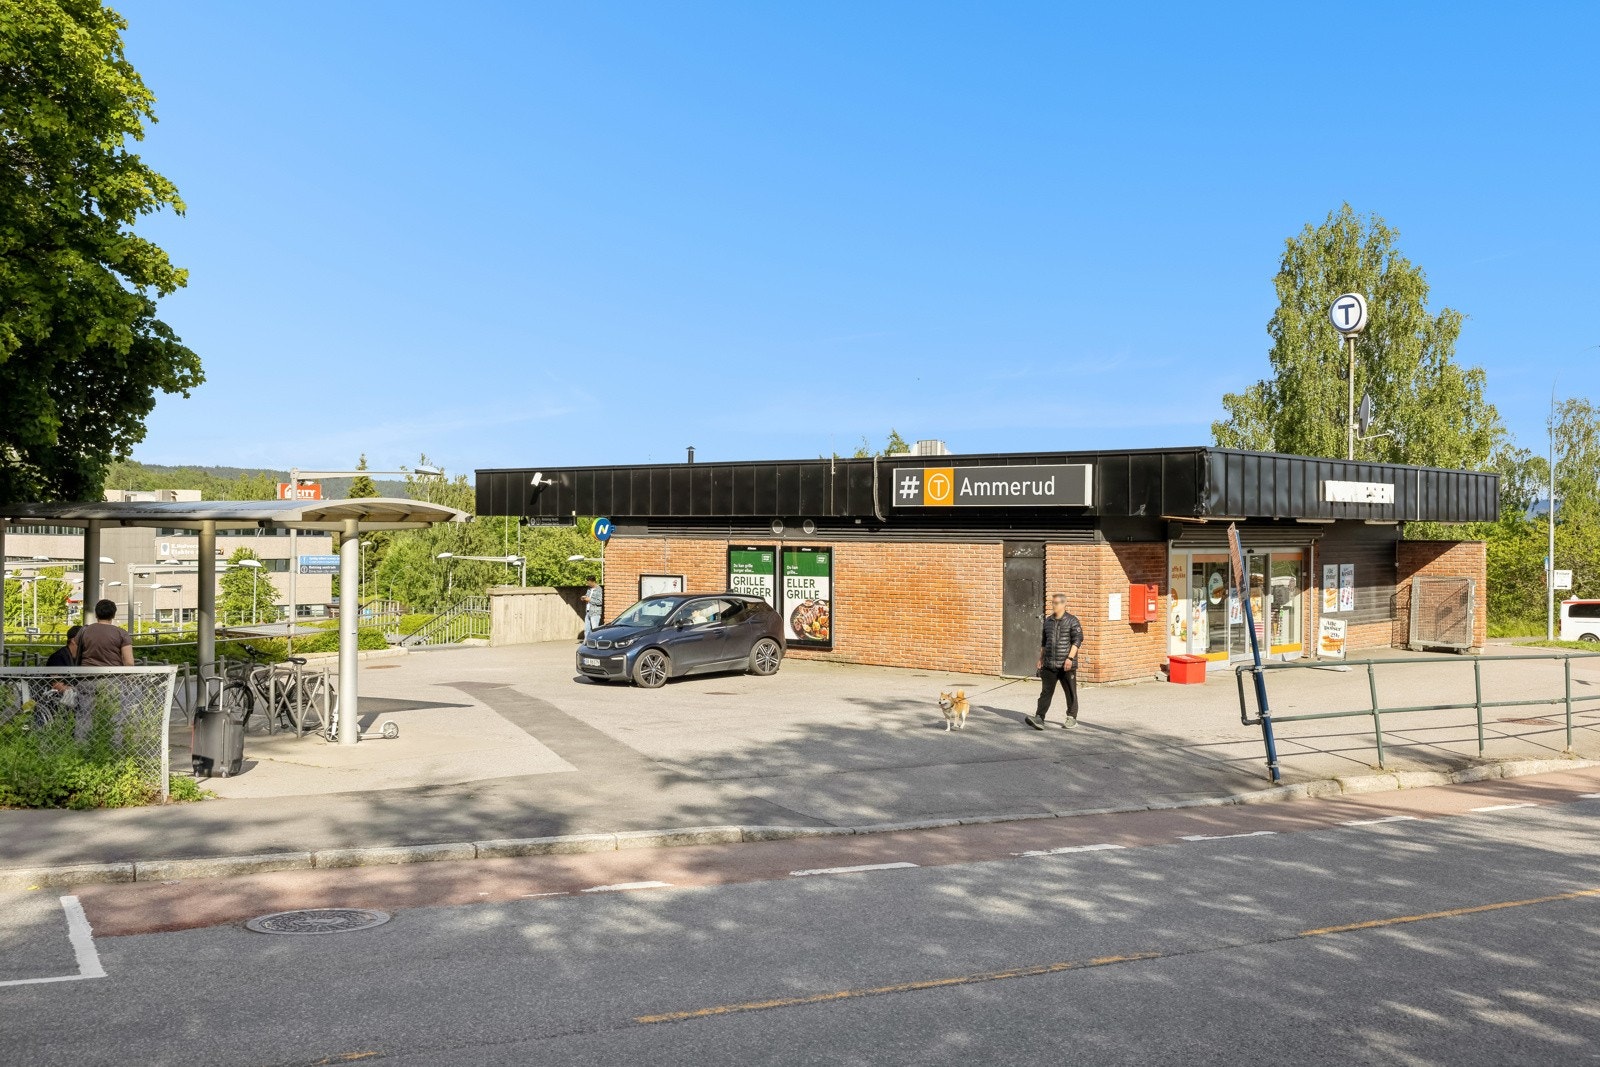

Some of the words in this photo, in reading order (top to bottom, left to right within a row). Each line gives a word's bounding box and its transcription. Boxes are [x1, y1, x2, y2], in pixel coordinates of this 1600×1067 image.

[1338, 303, 1355, 325] T
[959, 475, 1055, 496] Ammerud
[733, 576, 765, 587] GRILLE
[786, 578, 815, 588] ELLER
[786, 589, 820, 600] GRILLE
